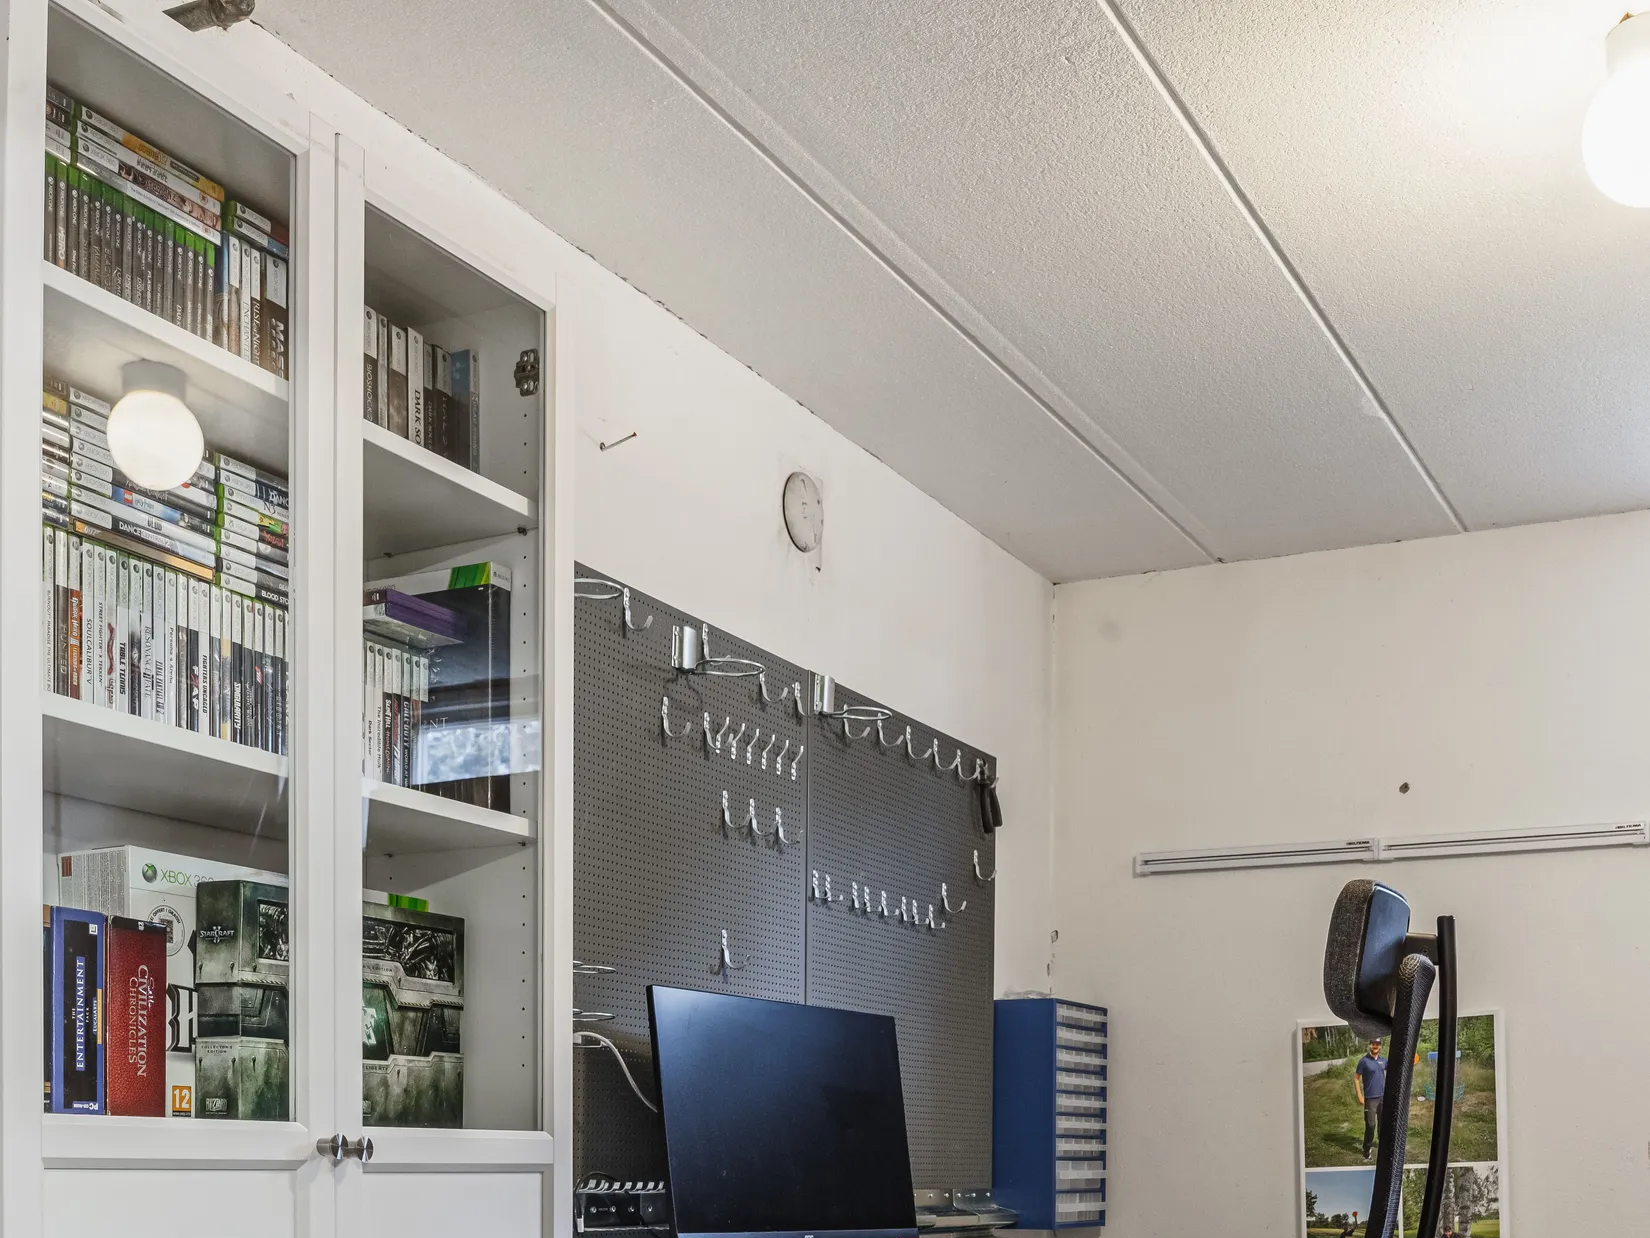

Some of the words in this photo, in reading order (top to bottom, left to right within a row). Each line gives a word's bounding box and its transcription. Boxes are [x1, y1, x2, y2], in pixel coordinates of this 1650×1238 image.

[119, 522, 140, 536] DANCE
[141, 529, 164, 544] CENTRAL
[261, 589, 278, 601] BLOOD
[161, 869, 192, 886] XBOX
[77, 959, 85, 1068] ENTERTAINMENT
[128, 977, 138, 1063] CHRONICLES
[137, 965, 149, 1077] CIVILIZATION
[174, 1089, 190, 1109] 12
